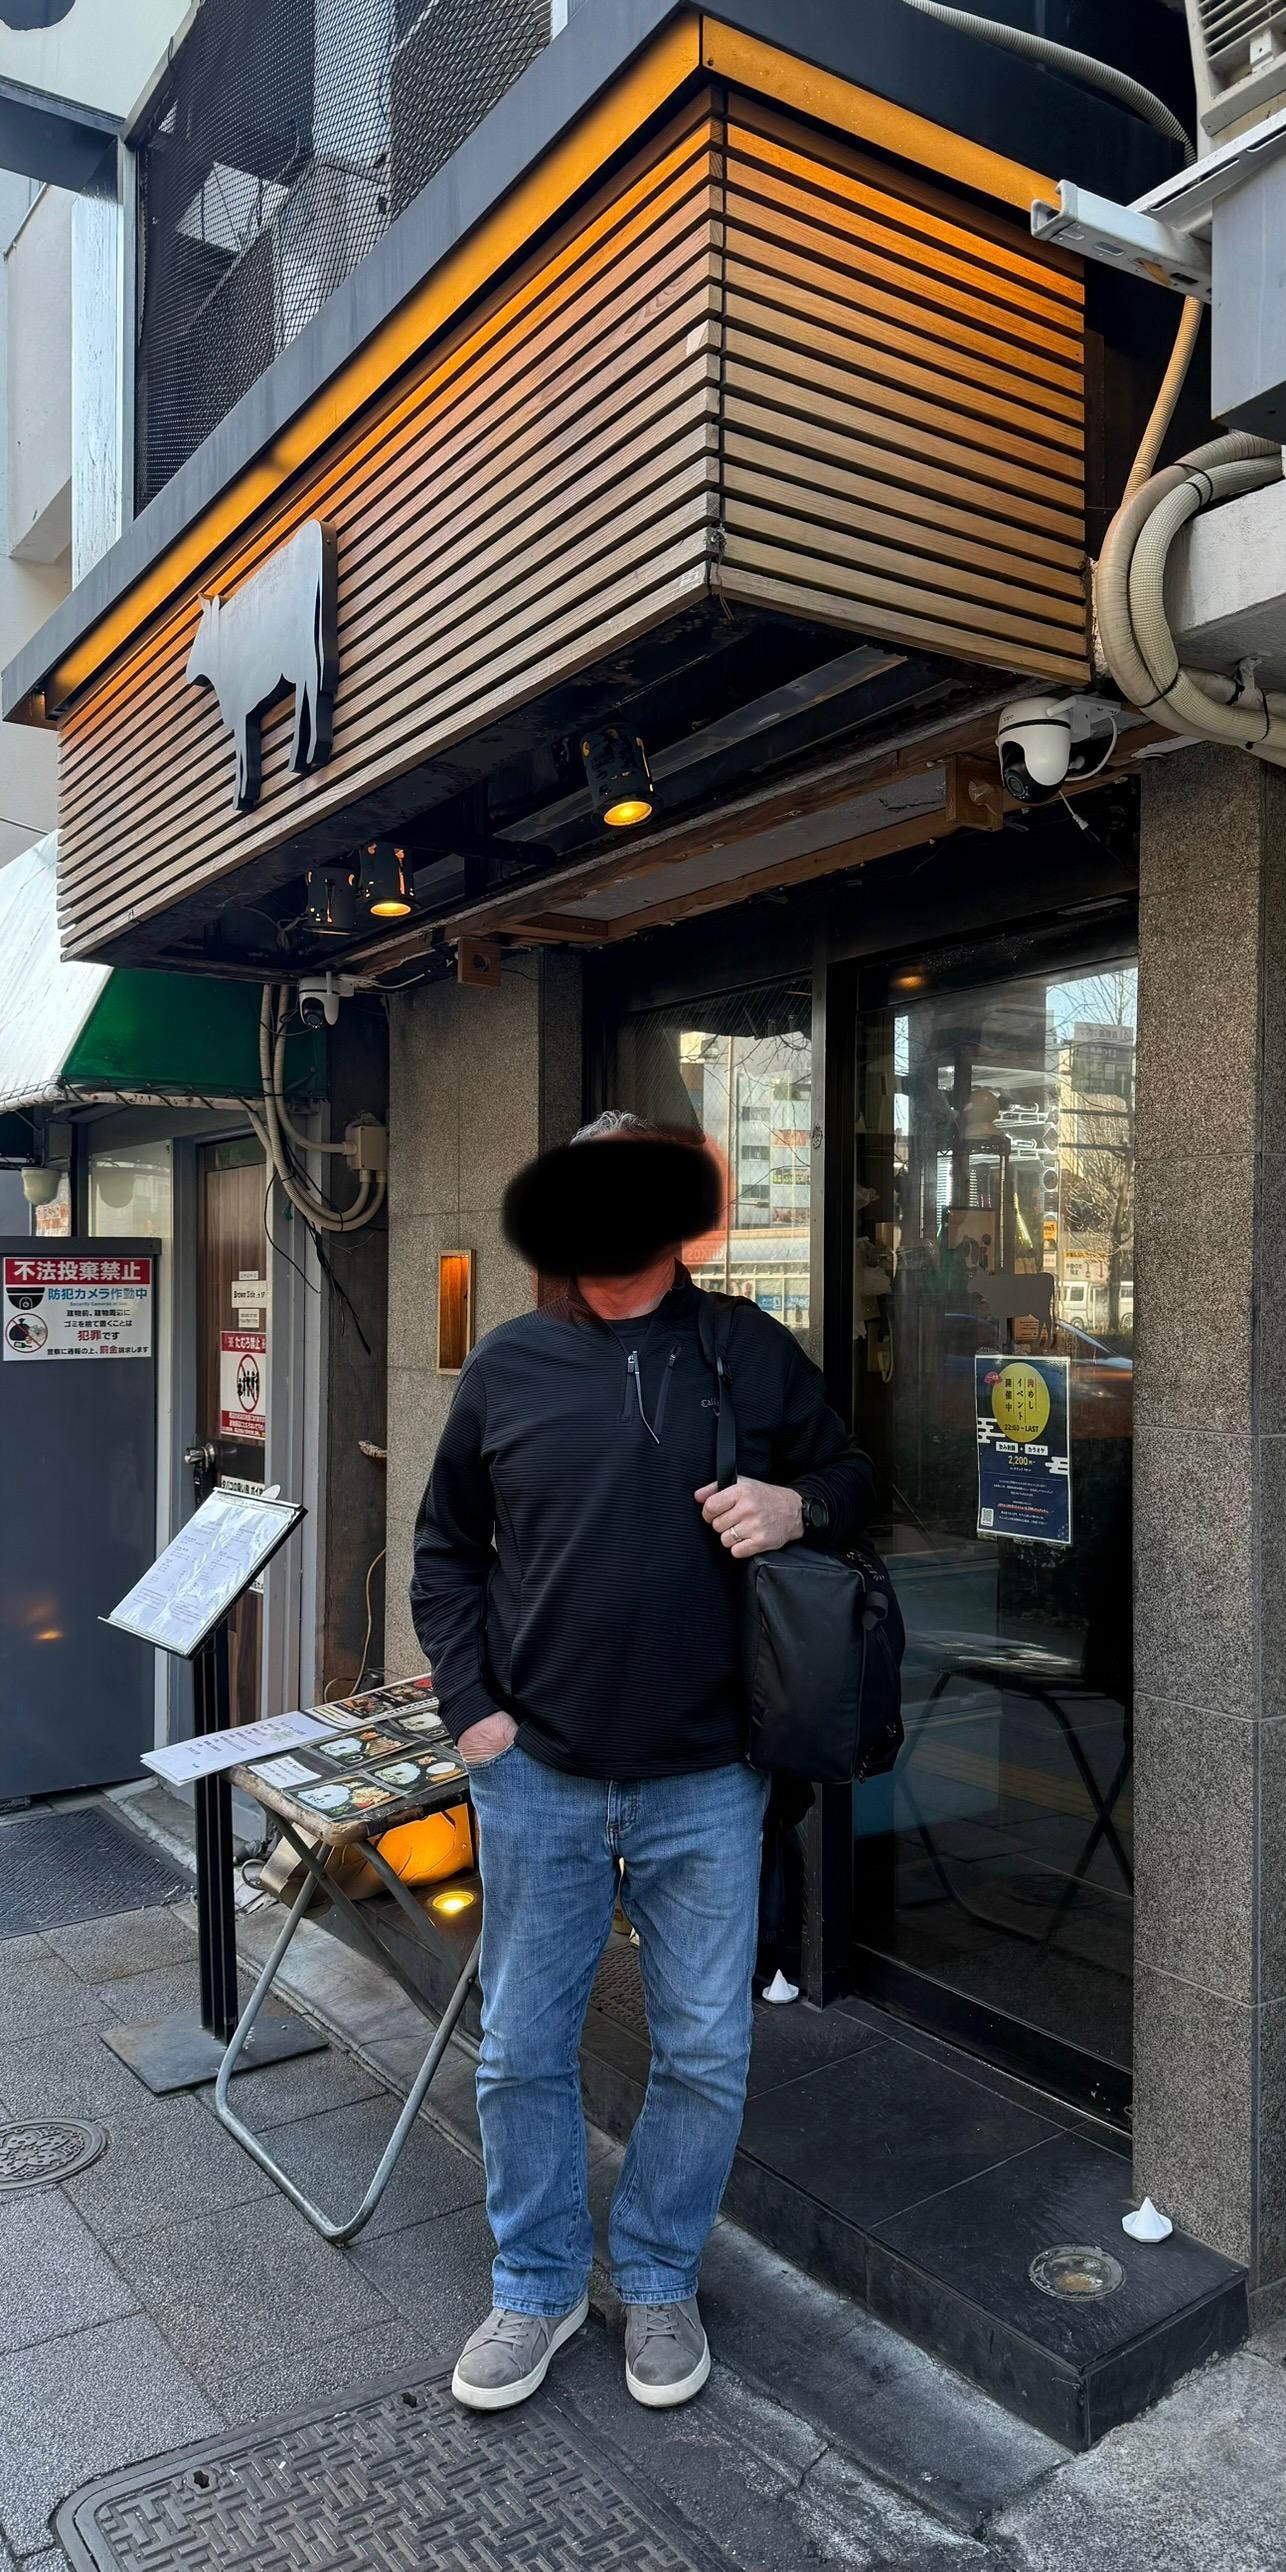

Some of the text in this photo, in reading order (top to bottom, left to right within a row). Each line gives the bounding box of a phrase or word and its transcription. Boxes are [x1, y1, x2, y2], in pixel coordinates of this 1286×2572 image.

[13, 1260, 142, 1281] 不法投棄禁止
[48, 1287, 148, 1301] 防犯カメラ作動中
[77, 1330, 120, 1341] 犯罪です
[1016, 1378, 1025, 1421] イベント
[1025, 1425, 1039, 1433] LAST
